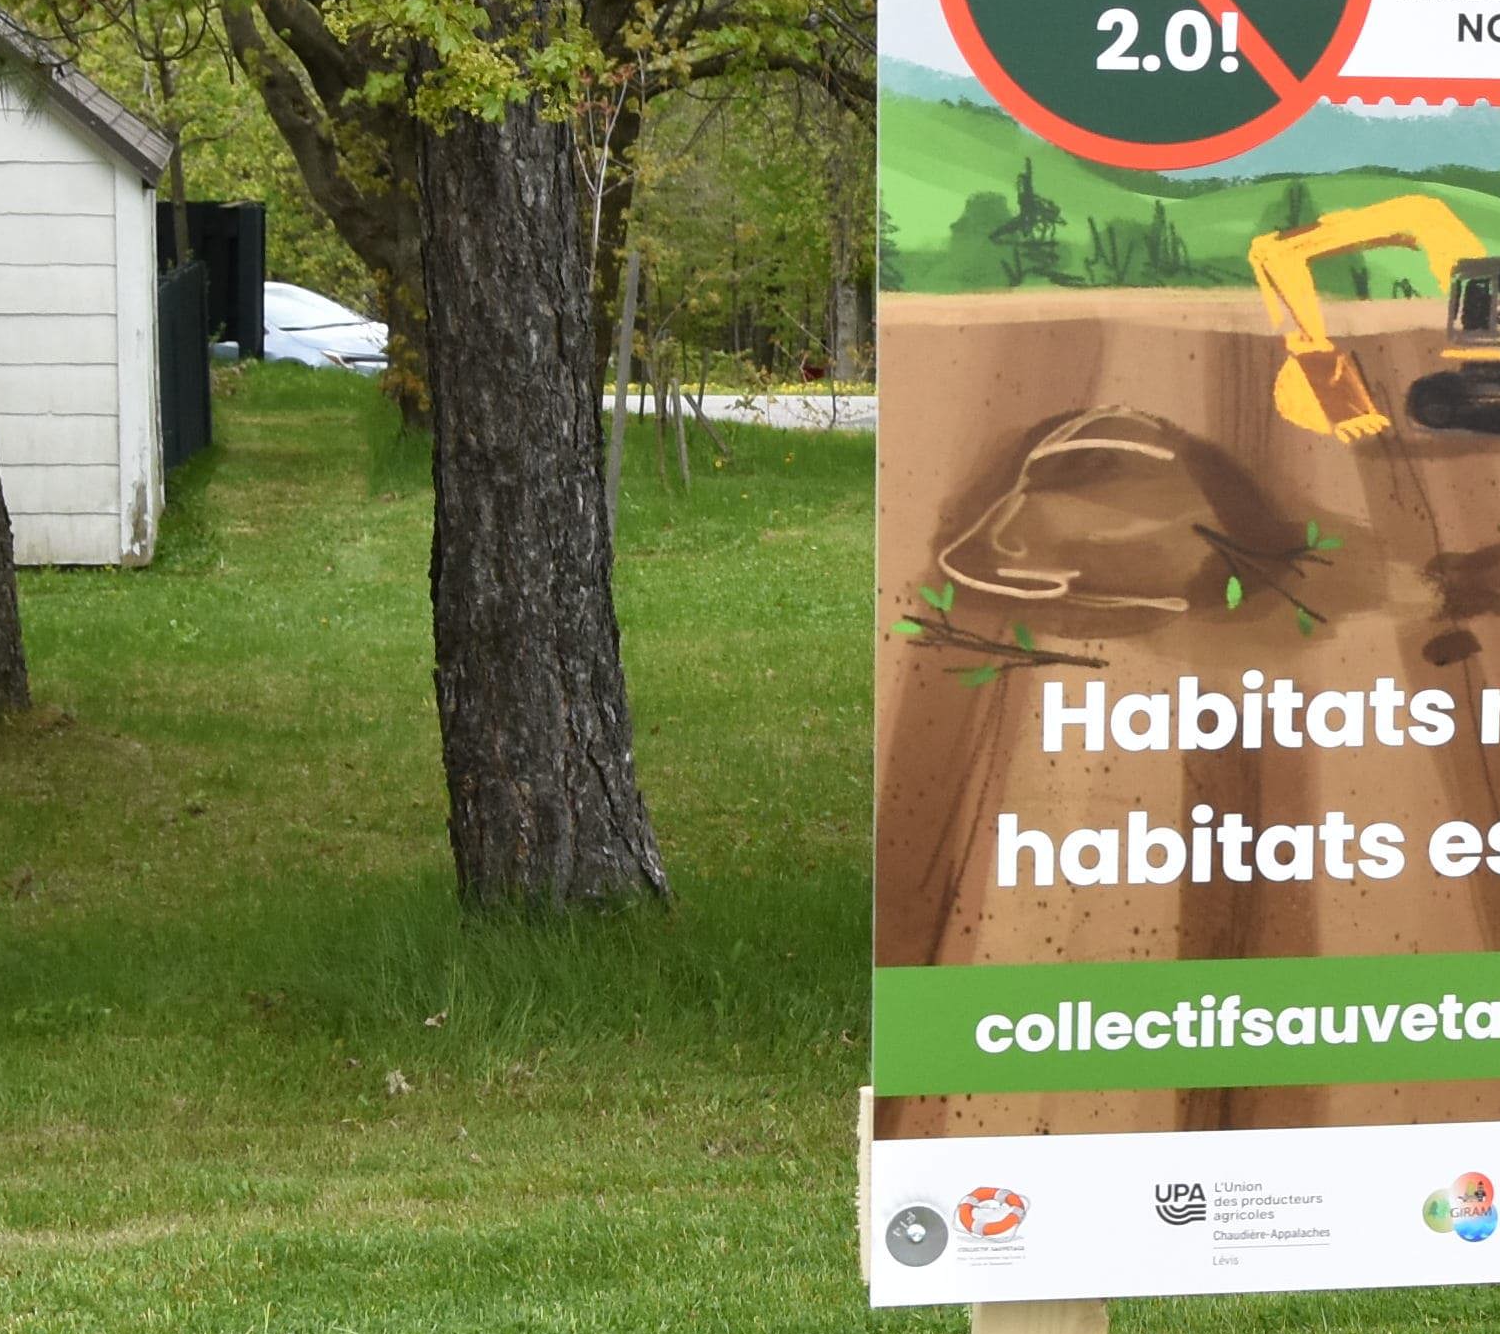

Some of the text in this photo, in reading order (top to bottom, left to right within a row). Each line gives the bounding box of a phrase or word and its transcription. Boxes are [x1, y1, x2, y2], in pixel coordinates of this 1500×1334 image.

[1096, 8, 1239, 73] 2.0!
[1042, 669, 1455, 752] Habitats
[997, 804, 1405, 887] habitats
[1155, 1183, 1206, 1203] UPA
[1214, 1181, 1263, 1193] L'Union
[1214, 1194, 1323, 1208] des producteurs
[1213, 1209, 1275, 1224] agricoles
[1213, 1228, 1331, 1241] Chaudière-Appalaches
